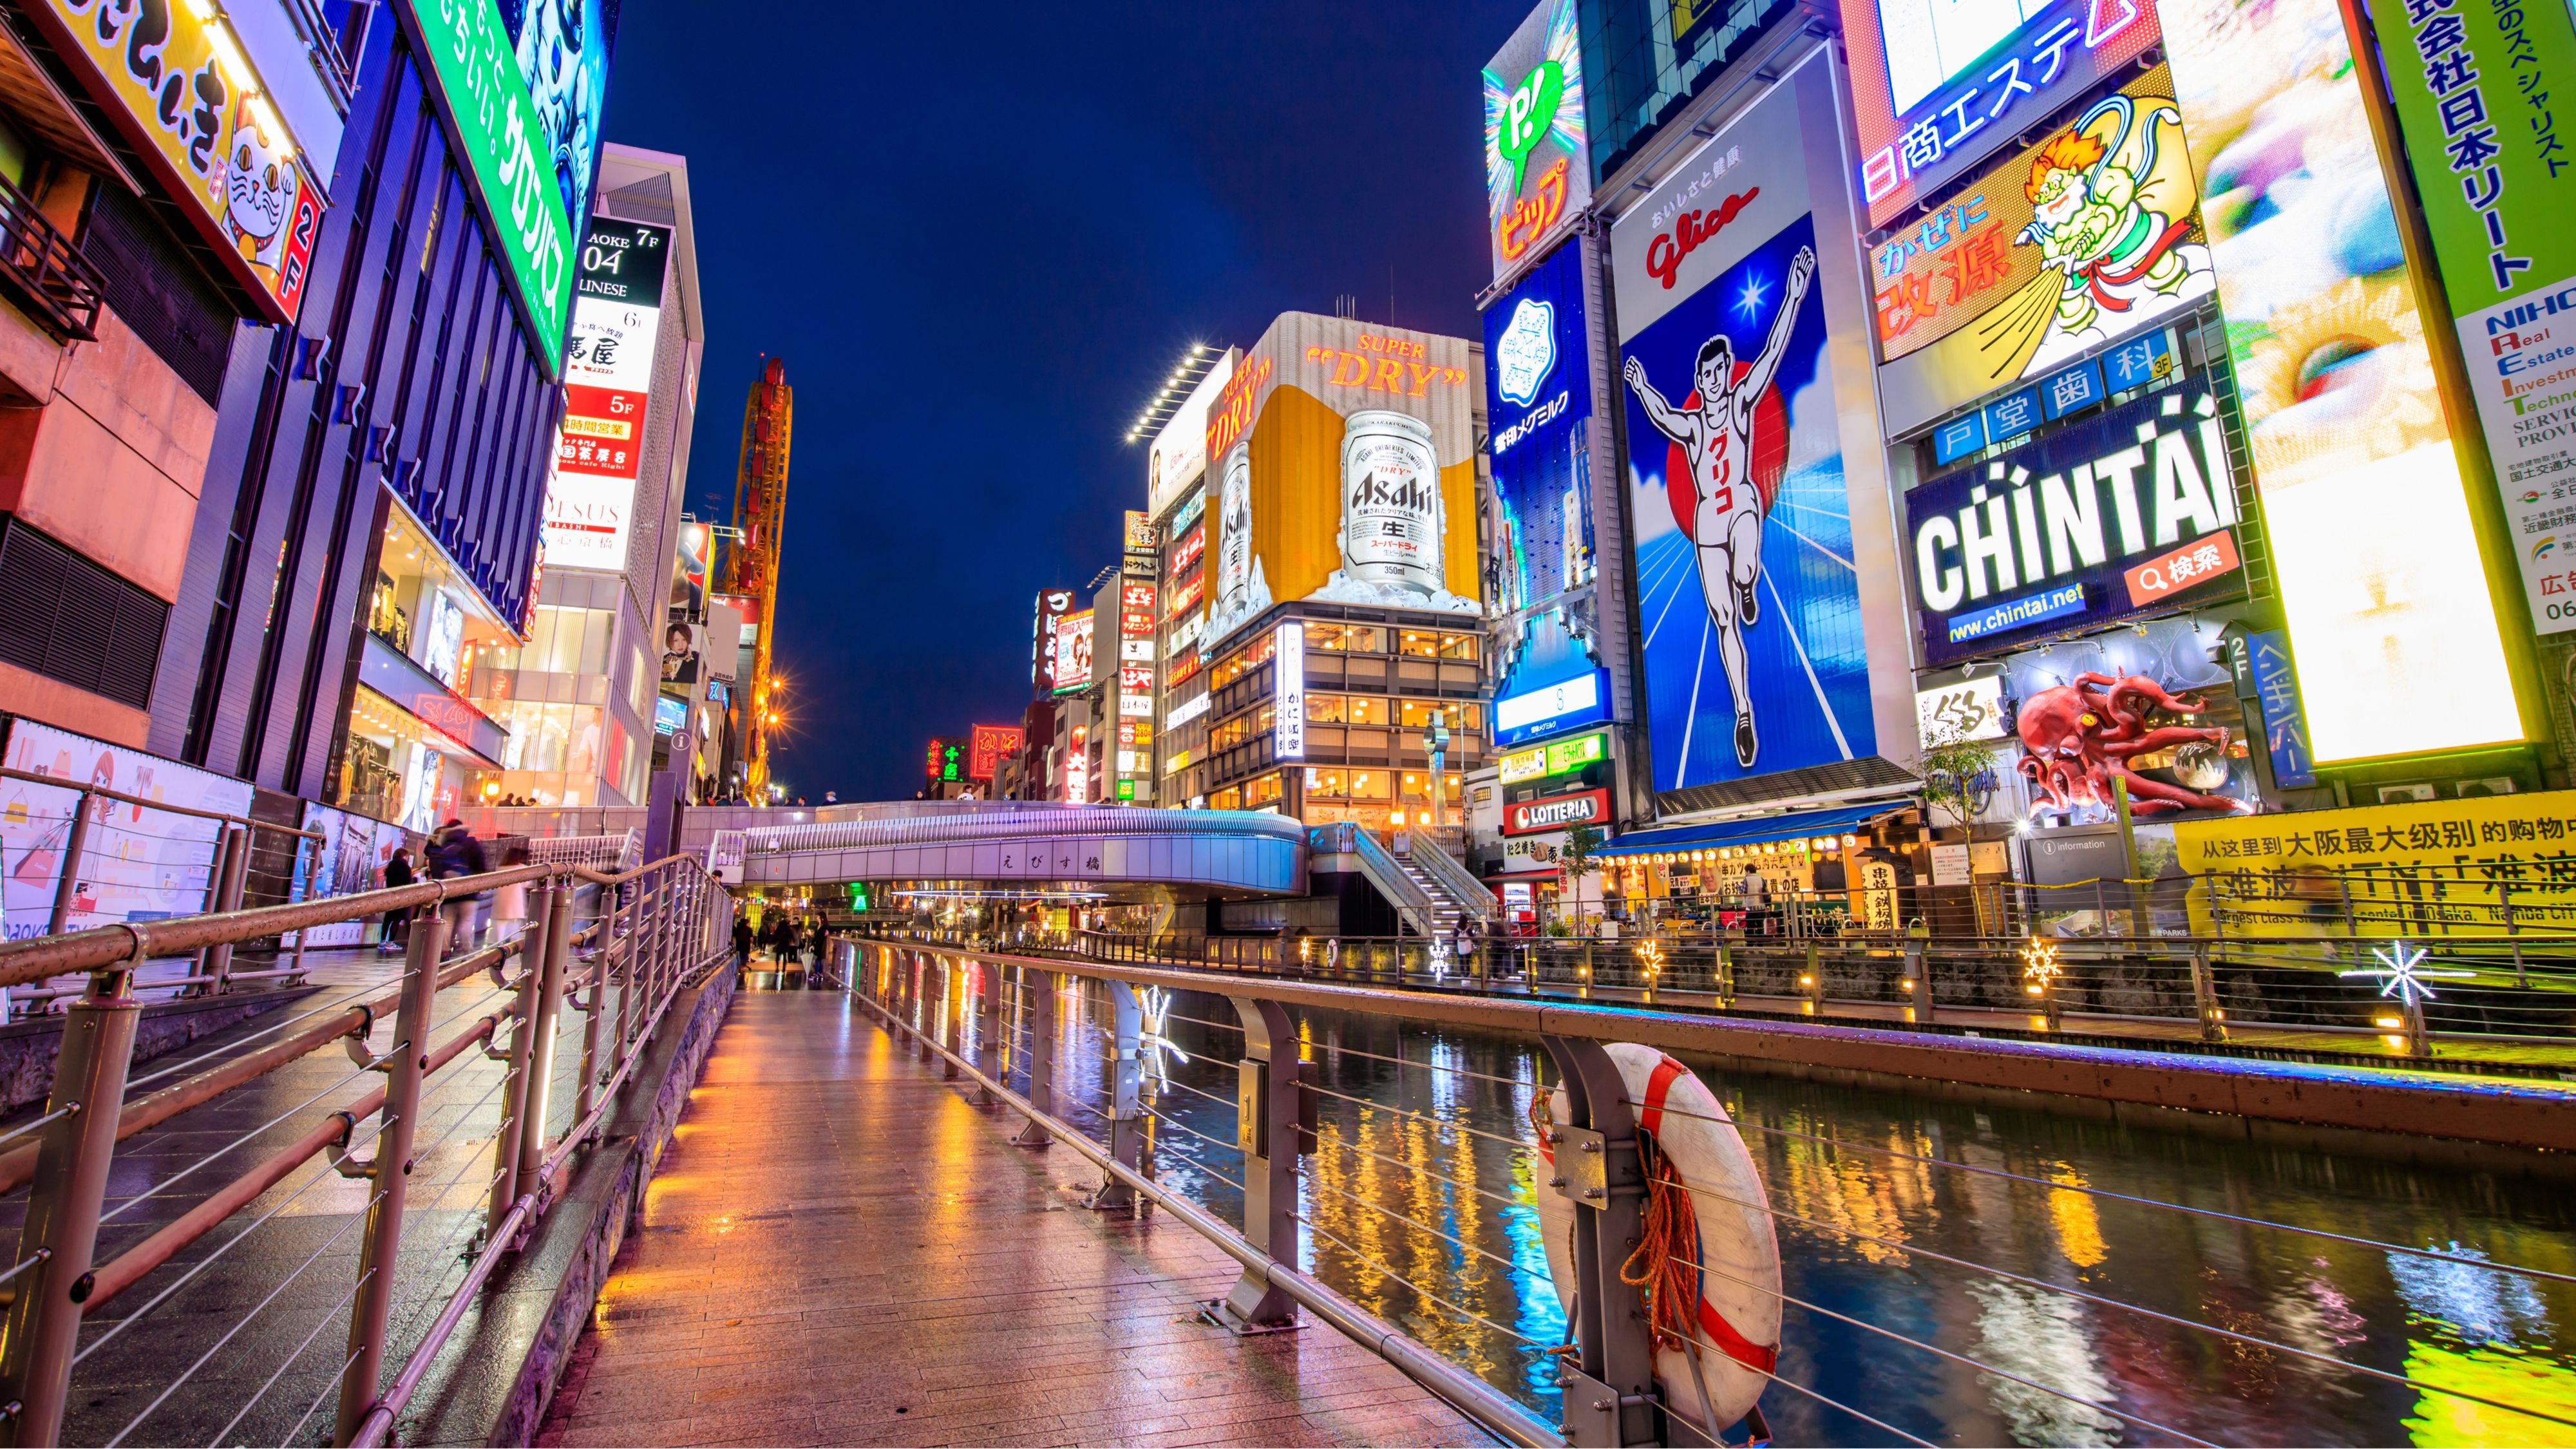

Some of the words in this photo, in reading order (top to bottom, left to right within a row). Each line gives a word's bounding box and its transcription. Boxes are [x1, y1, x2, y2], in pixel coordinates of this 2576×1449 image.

[1862, 0, 2138, 203] 日商エステム
[1651, 144, 1742, 229] おいしさと健康
[1501, 158, 1566, 260] ピップ
[636, 229, 659, 248] 7F
[1646, 186, 1760, 290] Glico
[1880, 194, 1988, 278] かぜに
[1875, 219, 2012, 341] 改源
[1359, 334, 1426, 359] SUPER
[2490, 328, 2550, 356] Real
[2497, 346, 2575, 376] Estate
[1224, 355, 1253, 404] SUPER
[610, 395, 634, 414] 5F
[1944, 339, 2154, 455] 戸堂歯科
[2154, 359, 2170, 374] 3F
[1495, 390, 1568, 454] 雪印メグミルク
[1707, 427, 1734, 516] グリコ
[1352, 471, 1433, 516] Asahi
[1222, 499, 1248, 553] Asahi
[1381, 520, 1406, 538] 生
[1230, 549, 1239, 567] 生
[1371, 540, 1418, 552] スーパードライ
[1384, 565, 1406, 576] 350ml
[2168, 544, 2222, 583] 検索
[1123, 623, 1153, 633] ダイニング
[2231, 637, 2248, 680] 2F
[2257, 641, 2306, 772] ペンギンバー
[979, 732, 1018, 752] かに
[1530, 799, 1590, 824] LOTTERIA
[1001, 854, 1101, 871] えびす橋
[1506, 839, 1536, 857] たこ焼き
[2057, 840, 2106, 851] information
